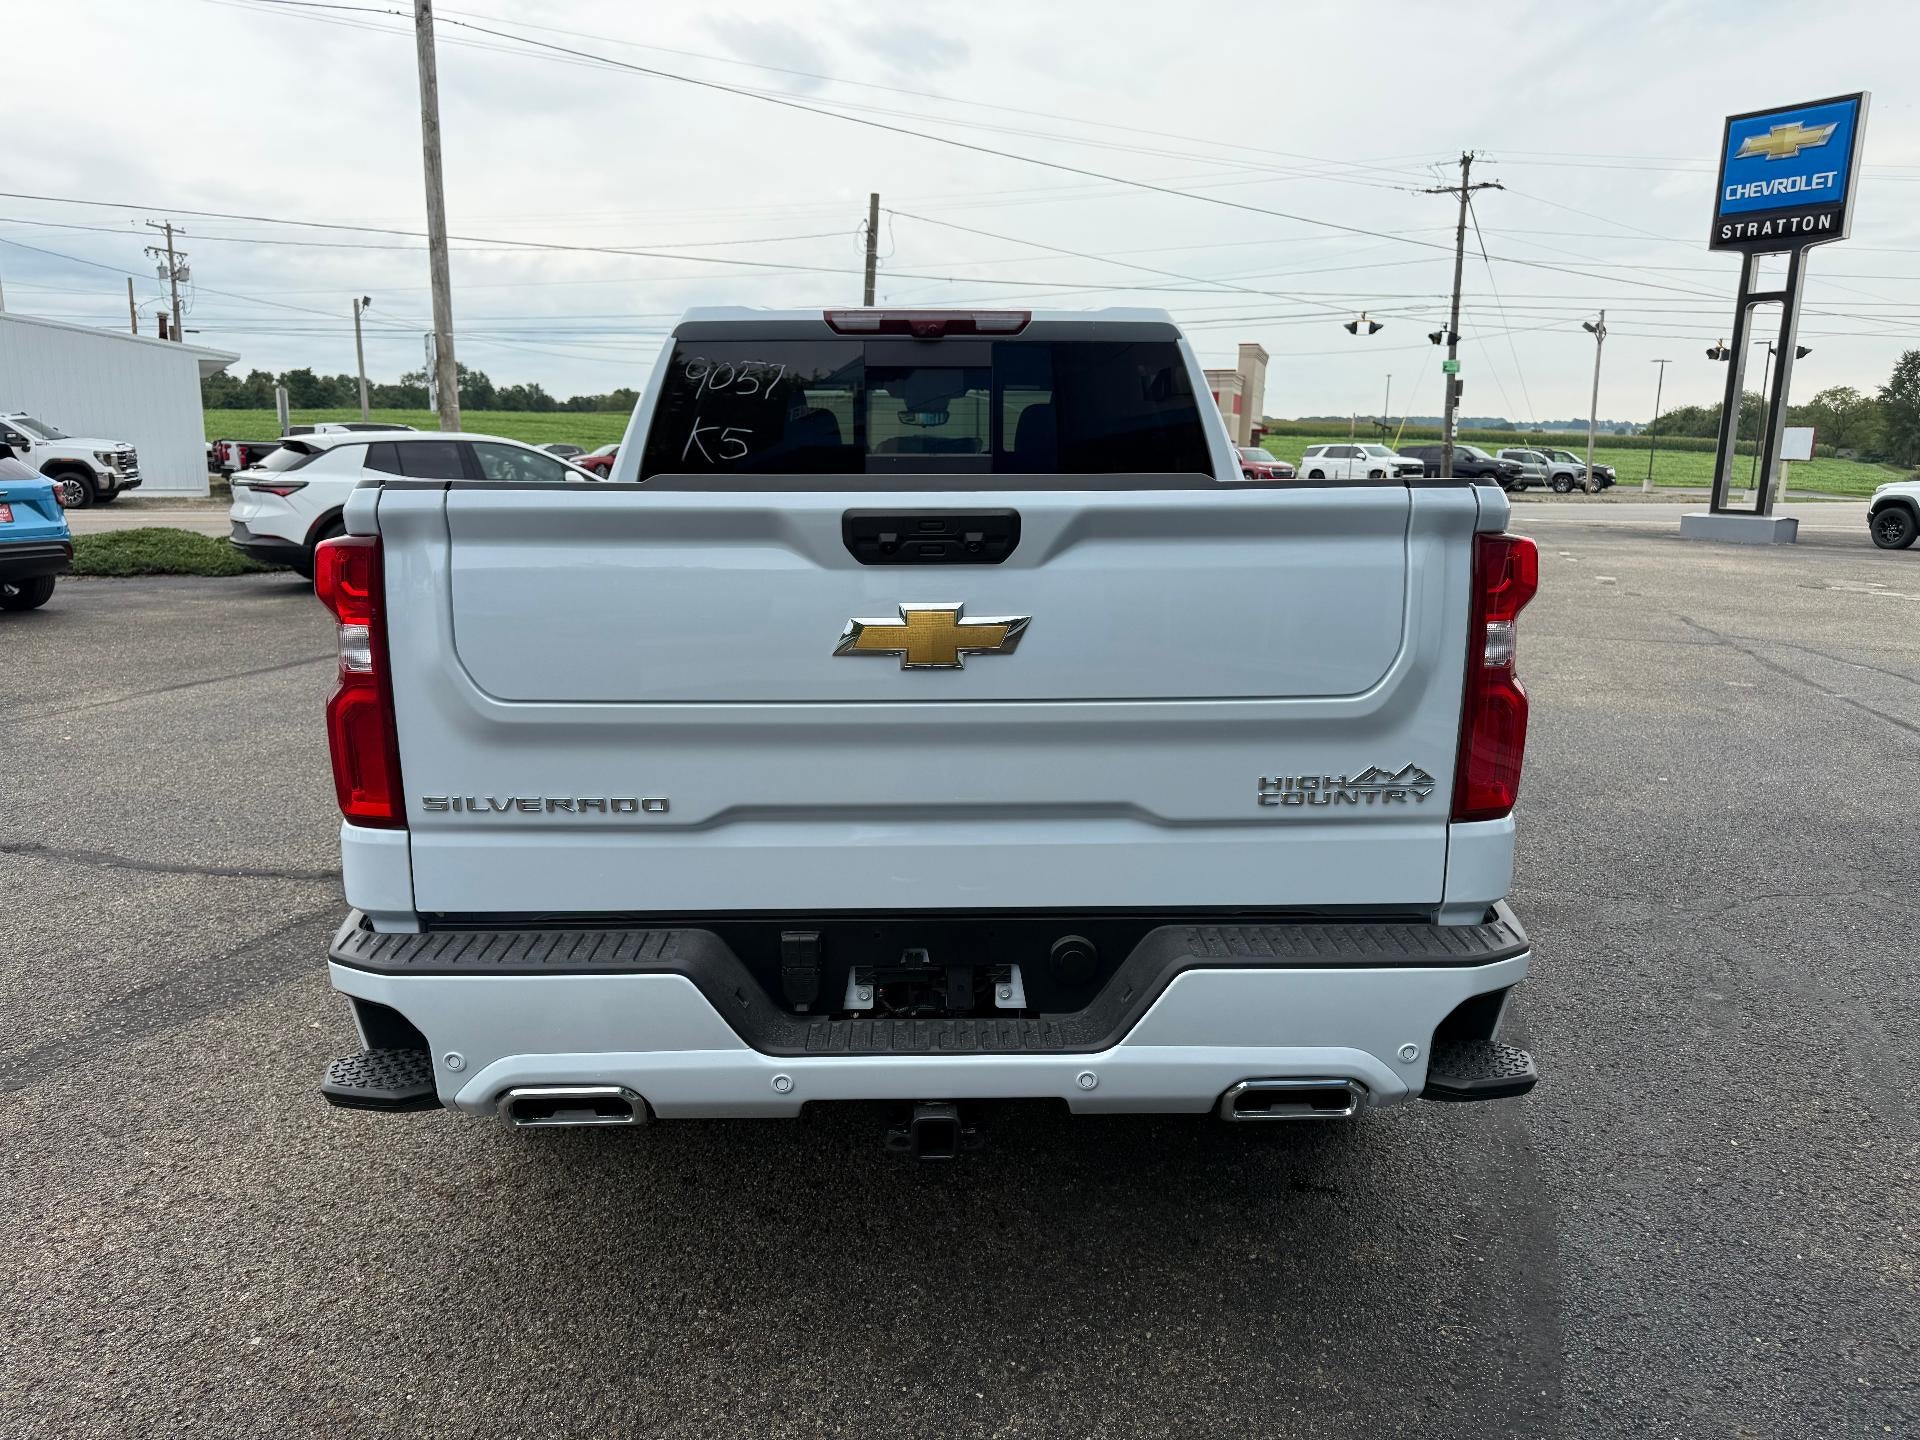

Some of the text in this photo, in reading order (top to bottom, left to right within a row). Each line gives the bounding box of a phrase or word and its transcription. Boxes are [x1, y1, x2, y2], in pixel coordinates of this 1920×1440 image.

[1725, 171, 1838, 200] CHEVROLET
[1721, 213, 1832, 239] STRATTON
[685, 356, 786, 400] 9057
[682, 416, 755, 463] K5
[1258, 774, 1348, 790] HIGH
[422, 796, 670, 813] SILVERADO
[1257, 788, 1433, 806] COUNTRY
